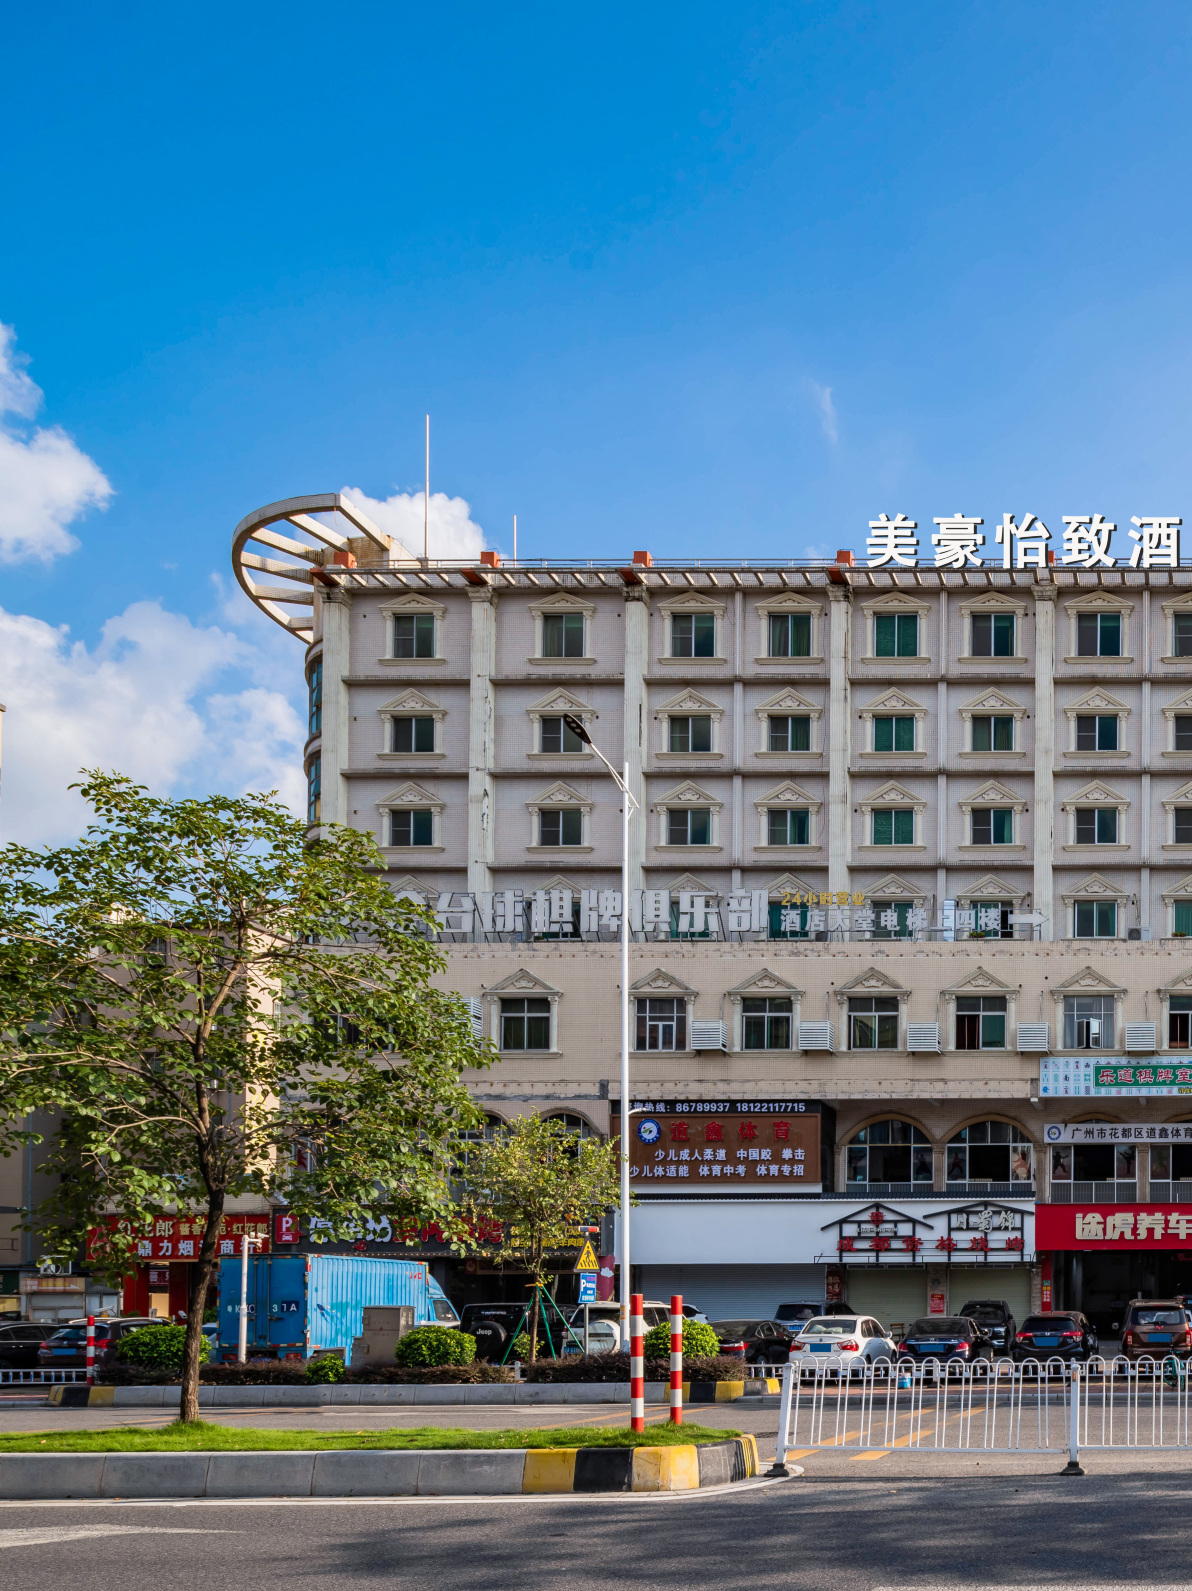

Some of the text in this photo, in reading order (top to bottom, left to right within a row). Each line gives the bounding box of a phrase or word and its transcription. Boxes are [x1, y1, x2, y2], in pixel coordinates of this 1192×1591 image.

[781, 891, 865, 906] 24小时营业
[780, 908, 1002, 932] 酒店大堂电梯上四楼
[675, 1102, 730, 1112] 86789937
[736, 1102, 806, 1112] 18122117715
[670, 1120, 792, 1142] 道鑫体育
[654, 1148, 806, 1161] 少儿成人柔道 中国跤 拳击
[629, 1164, 805, 1177] 少儿体适能 体育中考 体育专招
[282, 1217, 293, 1232] P
[138, 1239, 256, 1256] 鼎力烟商行
[836, 1235, 1025, 1252] 成都资格烧烤
[476, 1328, 493, 1336] Jeep
